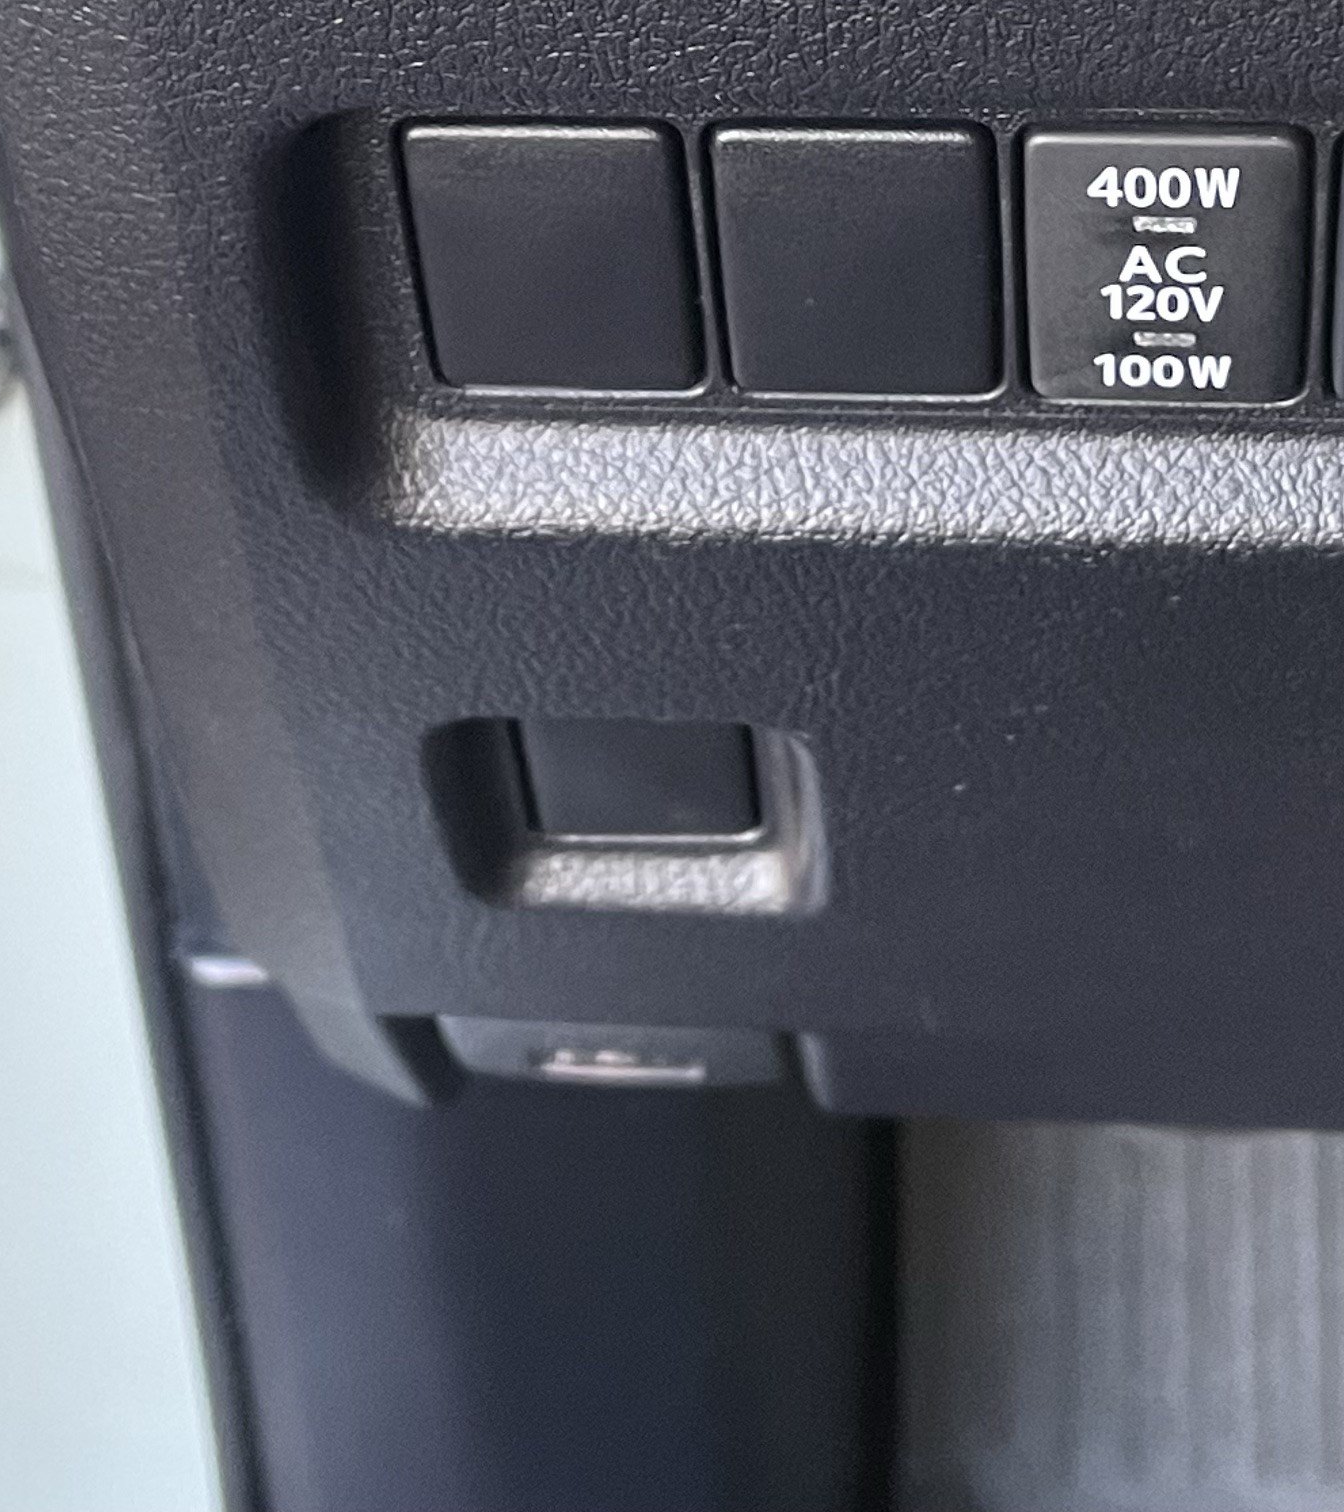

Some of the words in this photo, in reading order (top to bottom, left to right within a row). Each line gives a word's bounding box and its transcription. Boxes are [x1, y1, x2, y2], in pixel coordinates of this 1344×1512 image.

[1086, 165, 1241, 210] 400W
[1118, 244, 1209, 284] AC
[1099, 284, 1225, 324] 120V
[1092, 353, 1233, 389] 100W
